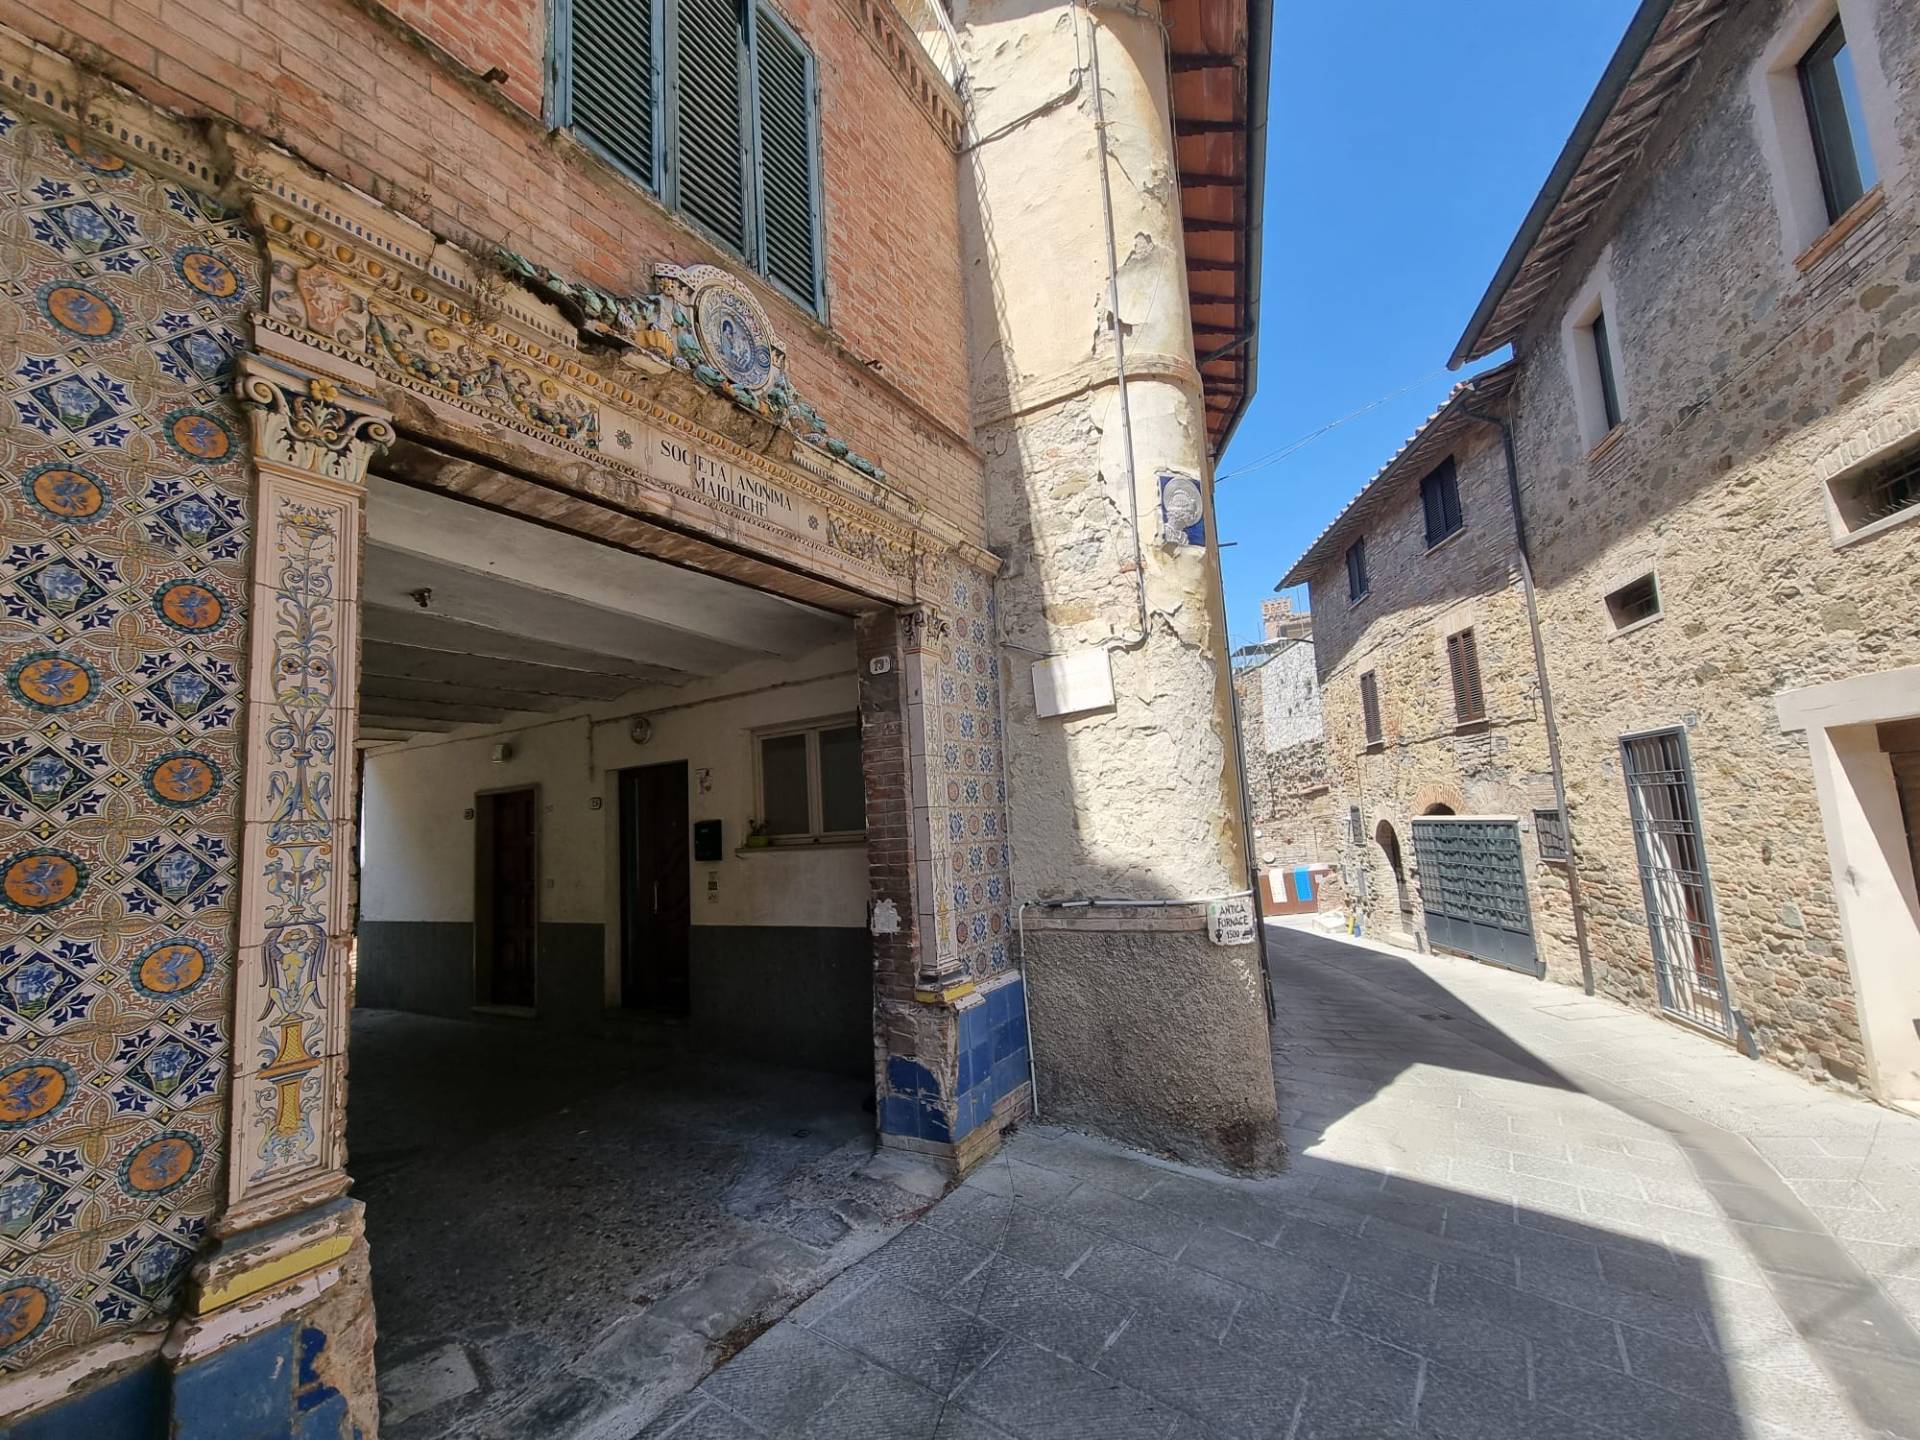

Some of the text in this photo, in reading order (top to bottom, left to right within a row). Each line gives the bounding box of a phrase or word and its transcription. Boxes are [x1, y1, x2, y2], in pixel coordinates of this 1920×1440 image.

[736, 475, 792, 512] ANONIMA
[1219, 904, 1246, 915] ANTICA
[1217, 915, 1249, 928] FORNACE
